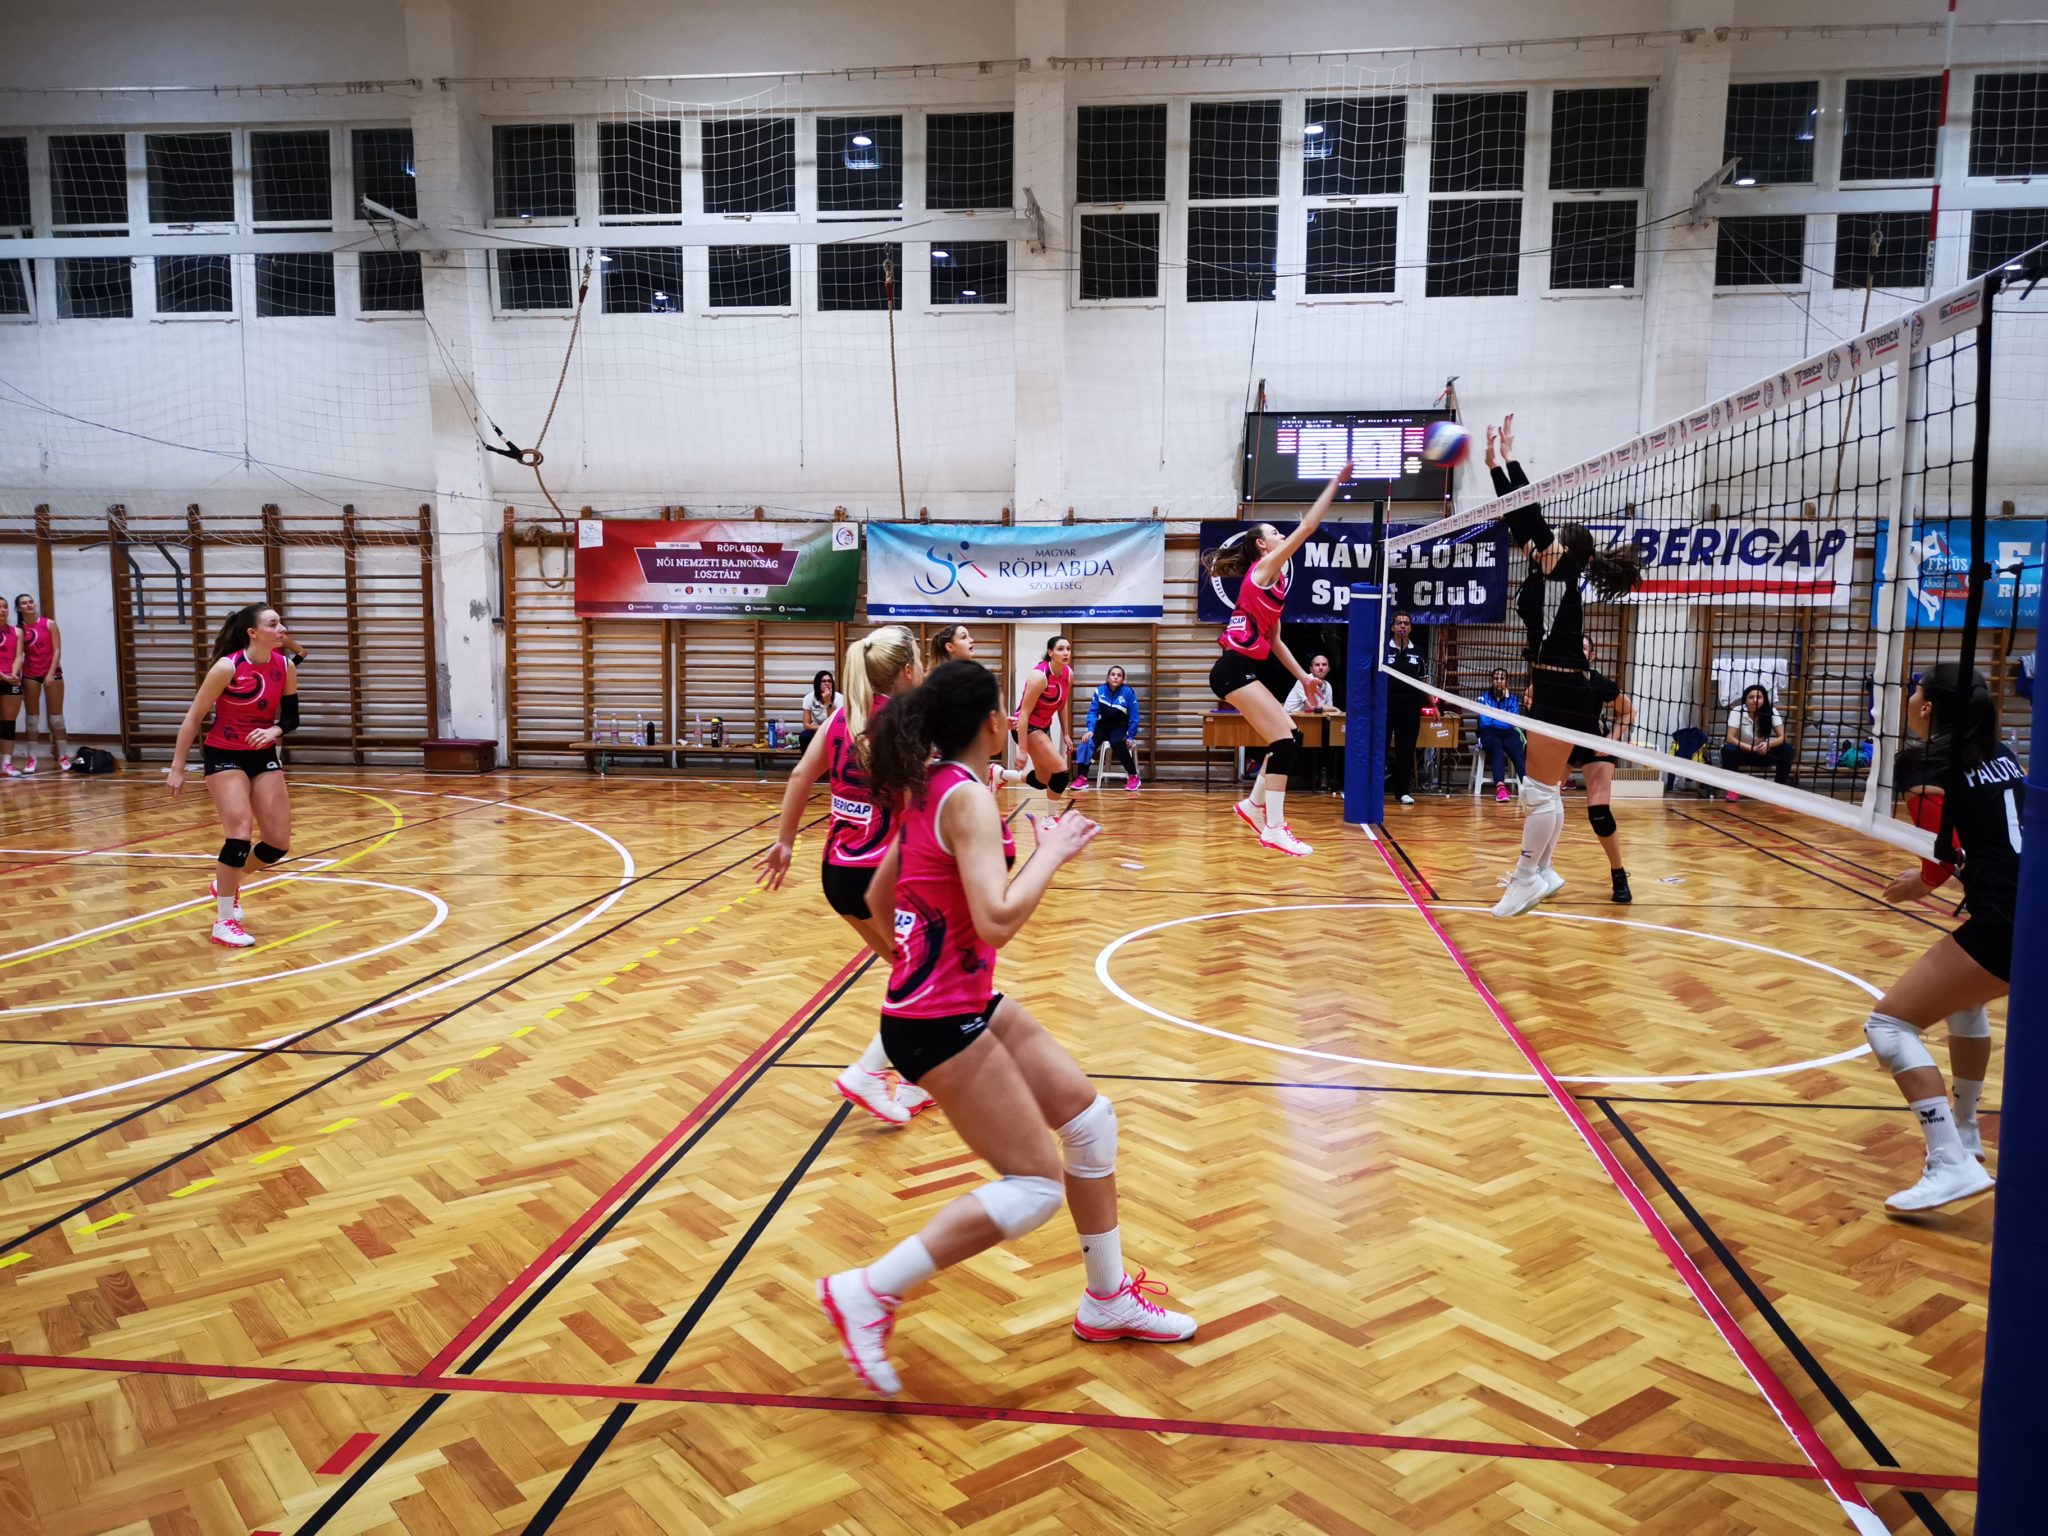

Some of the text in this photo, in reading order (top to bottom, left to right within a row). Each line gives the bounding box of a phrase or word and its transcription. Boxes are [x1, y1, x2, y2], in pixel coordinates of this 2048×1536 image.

[717, 543, 764, 553] RÖPLABDA
[1035, 548, 1076, 557] MAGYAR
[1304, 535, 1372, 568] MÁV
[1632, 528, 1845, 567] BERICAP
[676, 558, 719, 567] NEMZETI
[721, 558, 779, 569] BAJNOKSÁG
[1000, 557, 1115, 578] RÖPLABDA
[1311, 578, 1487, 611] Spt Club
[833, 798, 871, 815] BERICAP
